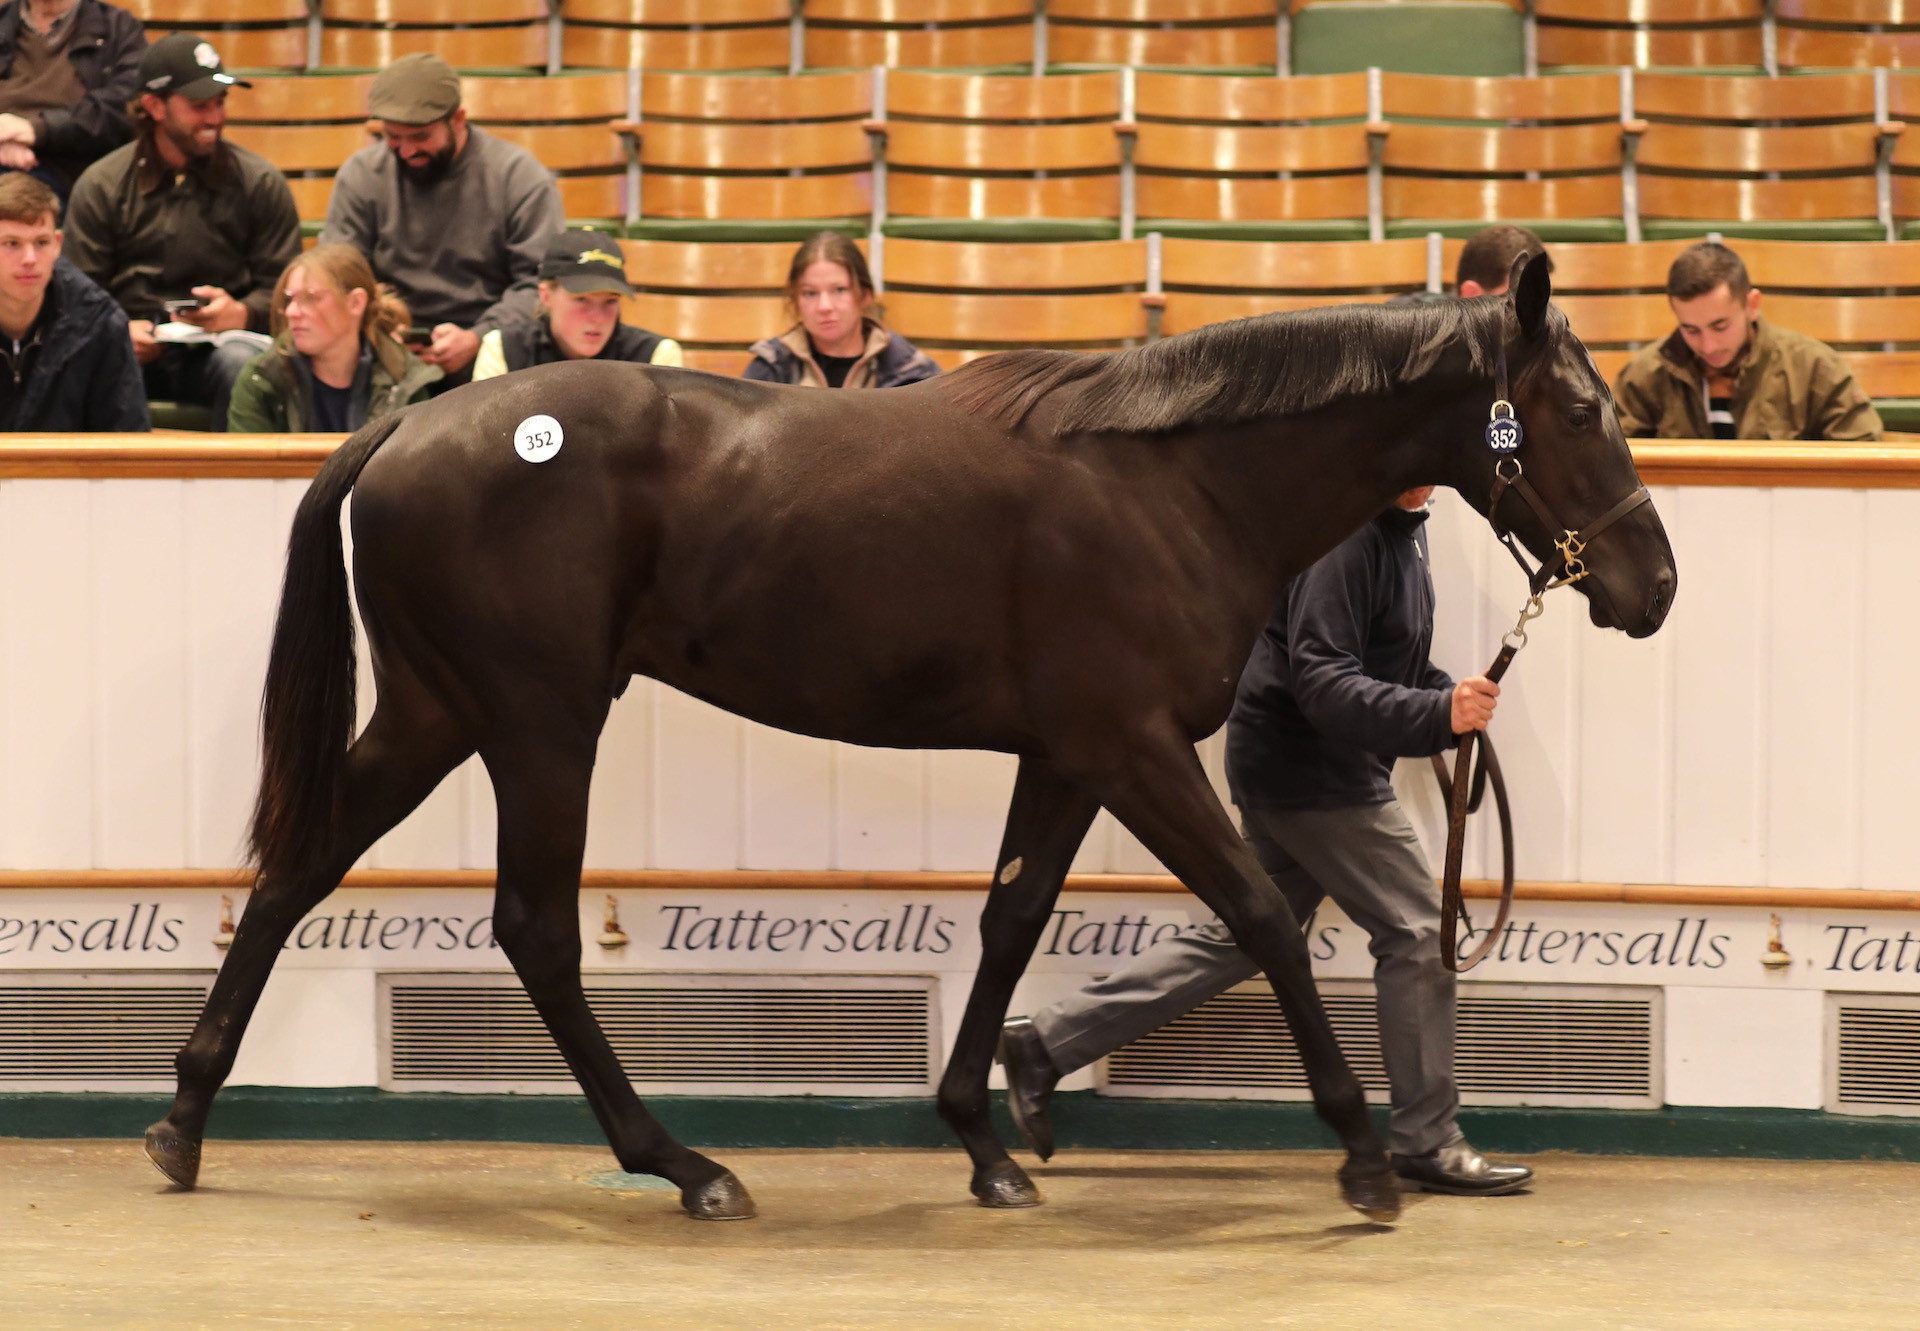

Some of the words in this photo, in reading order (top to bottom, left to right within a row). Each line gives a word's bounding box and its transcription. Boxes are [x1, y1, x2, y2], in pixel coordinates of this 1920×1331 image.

[525, 430, 554, 451] 352
[1490, 428, 1518, 449] 352
[282, 908, 498, 951] attersa
[658, 903, 956, 953] Tattersalls
[1456, 915, 1731, 969] attersalls
